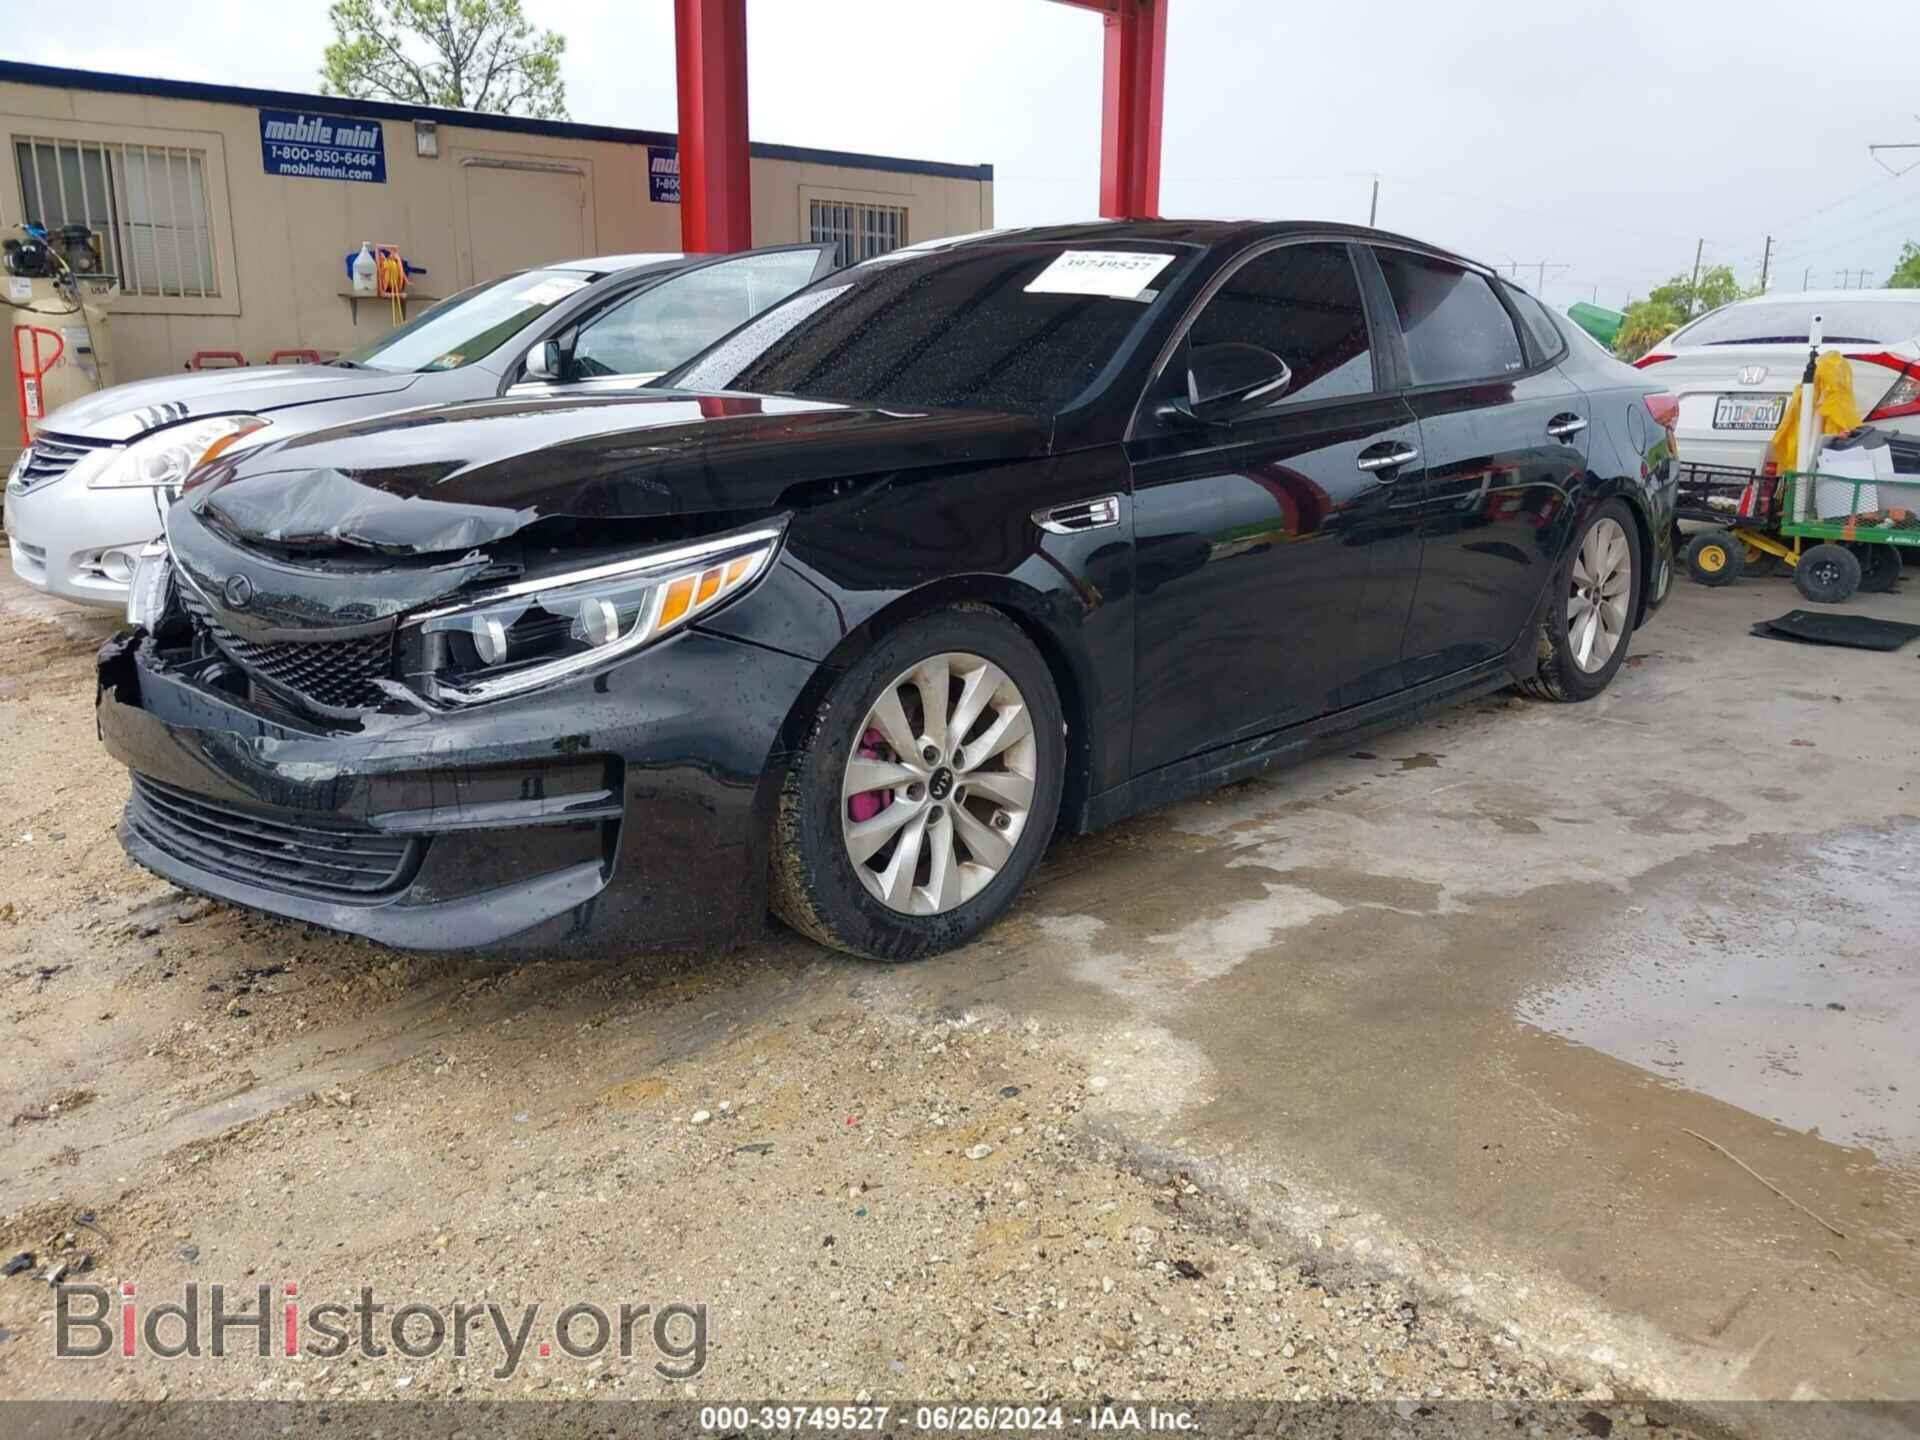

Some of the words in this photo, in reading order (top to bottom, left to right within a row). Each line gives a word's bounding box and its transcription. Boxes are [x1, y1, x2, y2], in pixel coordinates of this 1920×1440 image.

[265, 115, 333, 143] mobile
[335, 126, 378, 148] mini
[271, 146, 376, 166] 1-800-950-6464
[279, 163, 372, 180] mobilemini.com
